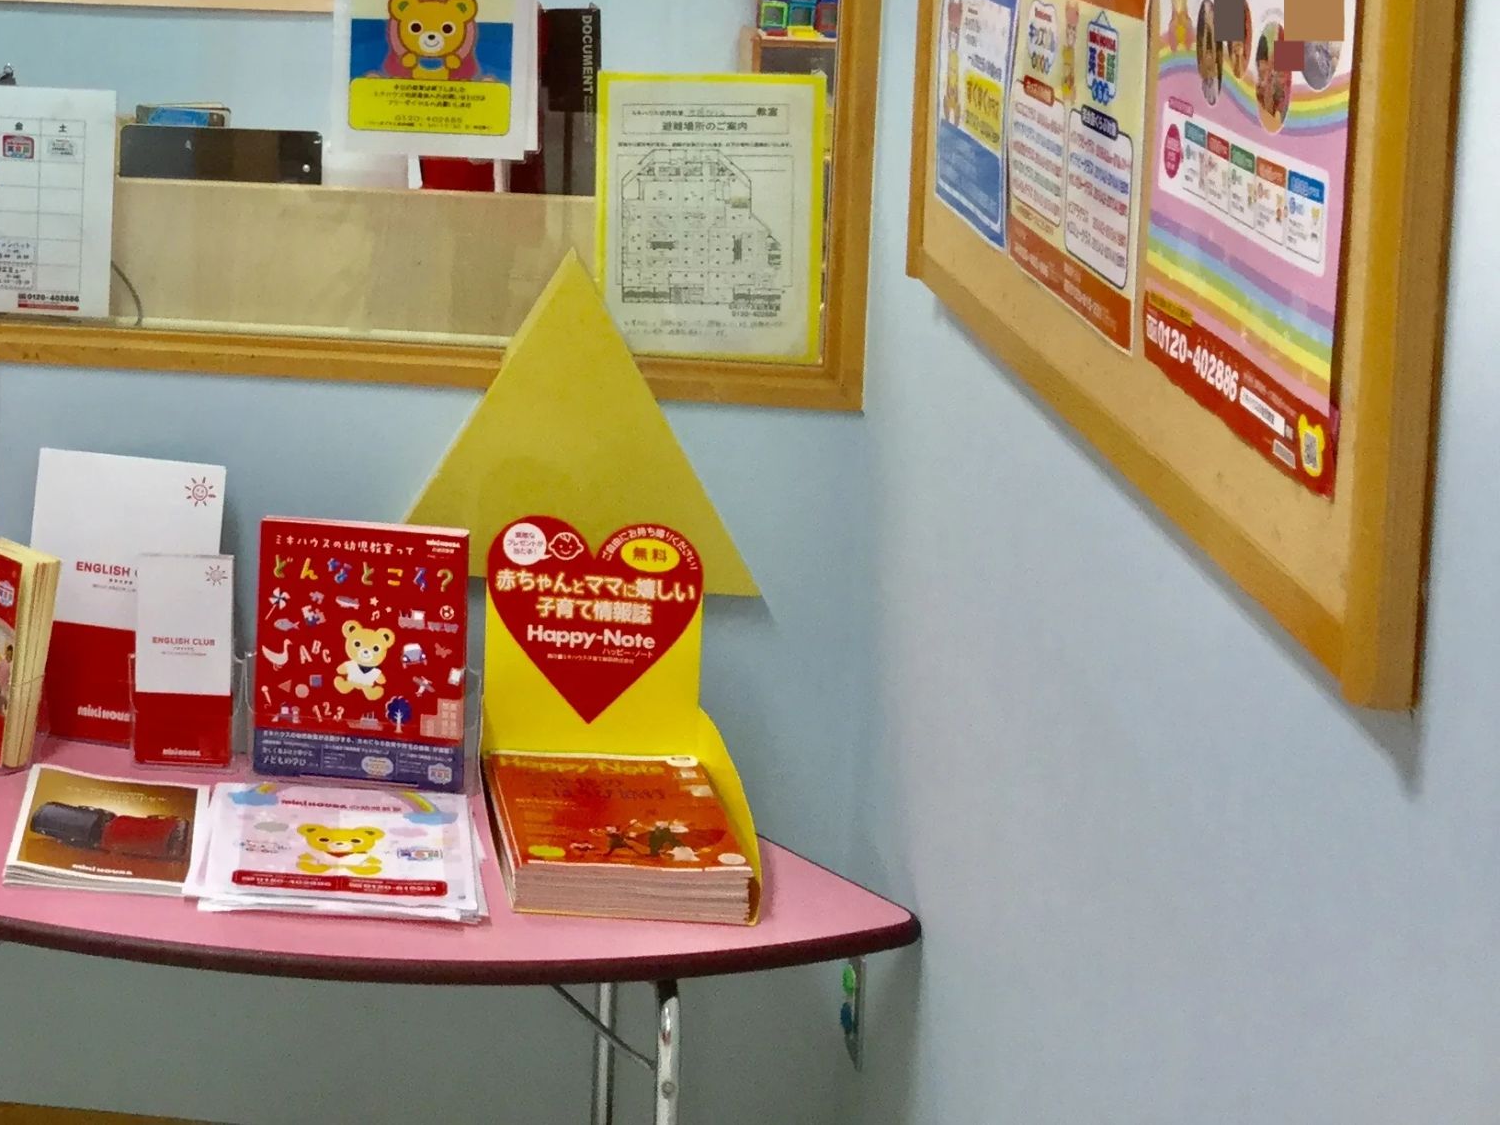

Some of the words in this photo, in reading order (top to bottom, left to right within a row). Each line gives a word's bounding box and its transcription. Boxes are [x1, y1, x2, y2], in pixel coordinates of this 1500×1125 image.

[581, 15, 594, 93] DOCUMENT
[1158, 321, 1239, 402] 0120-402886
[276, 534, 415, 556] ミキハウスの幼児教室って
[632, 547, 668, 563] 無料
[76, 561, 131, 578] ENGLISH
[496, 569, 695, 602] 赤ちゃんとママに嬉しい
[536, 597, 653, 625] 子育て情報誌
[152, 636, 189, 646] ENGLISH
[192, 637, 215, 646] CLUB
[527, 625, 655, 650] Happy-Note
